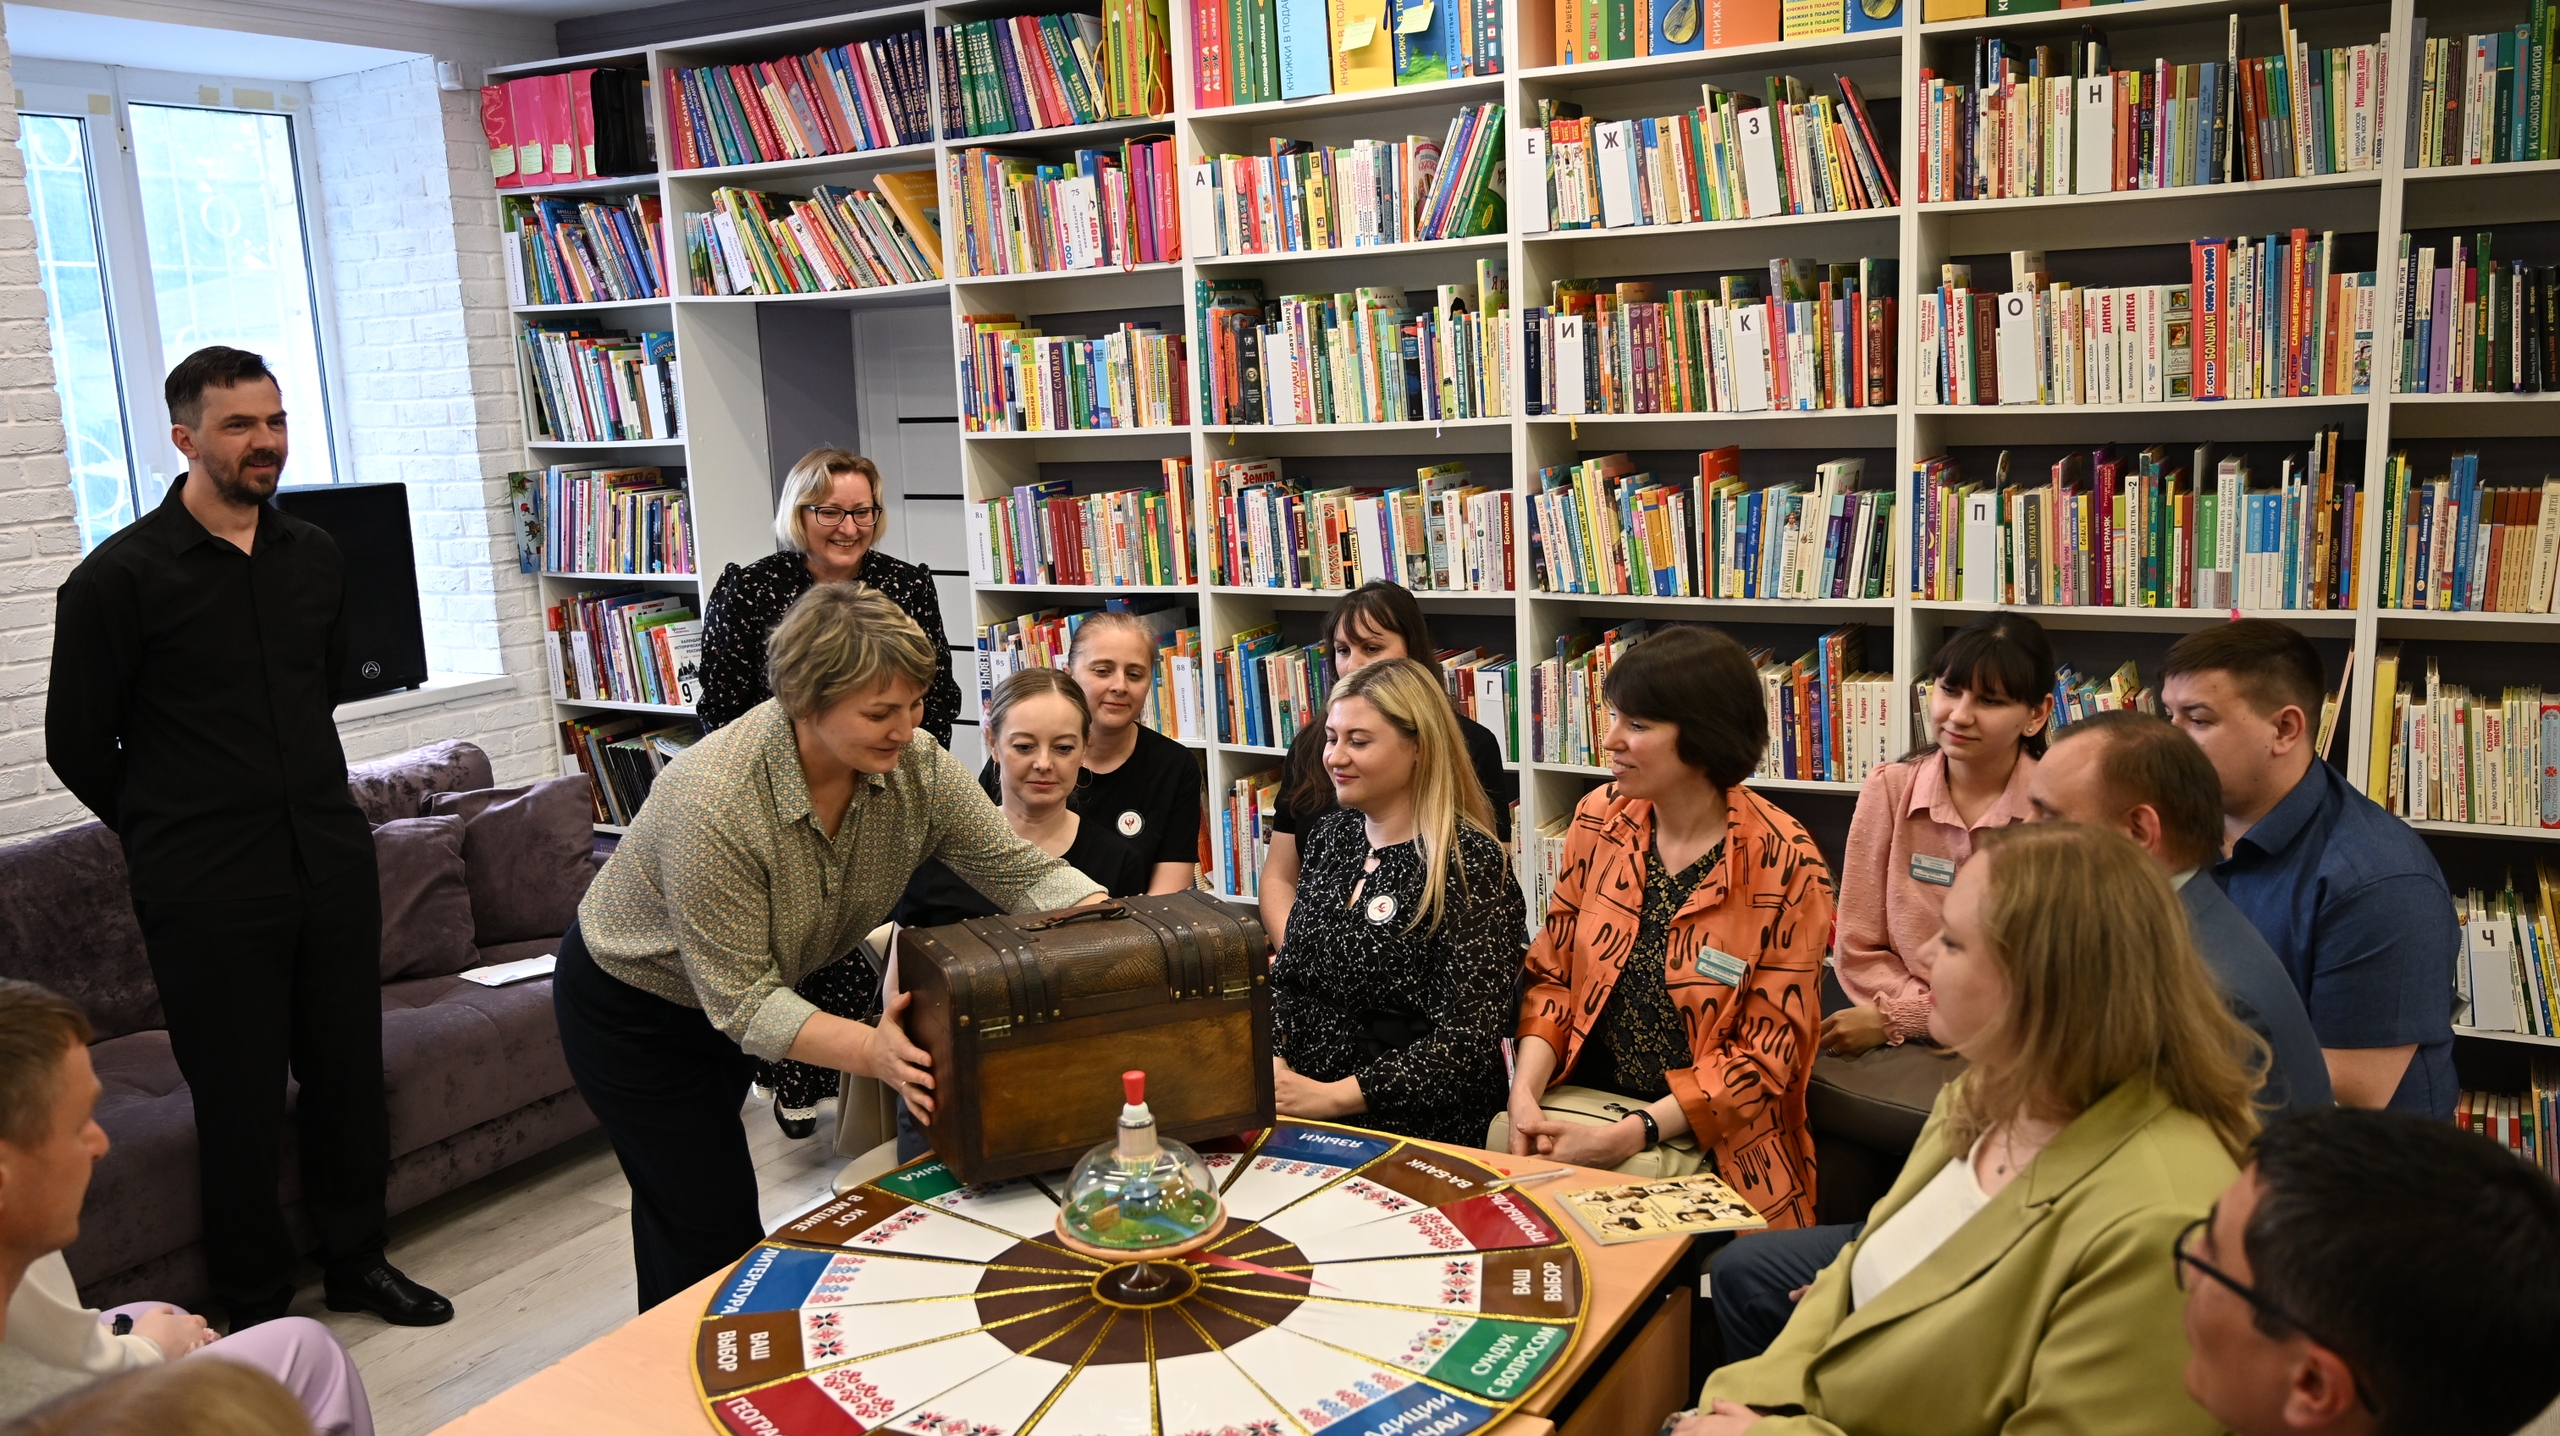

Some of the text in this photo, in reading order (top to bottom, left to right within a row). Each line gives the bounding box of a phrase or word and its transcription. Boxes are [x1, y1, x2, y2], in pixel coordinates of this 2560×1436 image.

[1813, 1, 1841, 9] ПОДАРОК
[1813, 10, 1841, 18] ПОДАРОК
[1786, 30, 1807, 38] КНИЖКИ
[1813, 26, 1841, 34] ПОДАРОК
[1813, 18, 1841, 26] ПОДАРОК
[955, 34, 967, 75] БАСНИ
[1201, 46, 1211, 92] АЗБУКА
[1212, 45, 1221, 91] АЗБУКА
[1237, 42, 1247, 95] ВОЛШЕБНЫЙ
[1259, 13, 1270, 97] ВОЛШЕБНЫЙ КАРАНДАШ
[1284, 45, 1294, 91] КНИЖКИ
[871, 72, 883, 101] МЕДВЕДЯ
[2354, 50, 2366, 108] Мишкина каша
[2090, 85, 2101, 104] Н
[2530, 45, 2542, 149] И. СОКОЛОВ-МИКИТОВ
[680, 94, 695, 163] ЛЕСНЫЕ СКАЗКИ
[1603, 131, 1619, 149] Ж
[1723, 113, 1731, 140] ЖИВОТНЫХ
[1528, 138, 1535, 154] Е
[1071, 188, 1079, 196] 75
[1196, 171, 1205, 185] А
[1088, 216, 1099, 249] СПОРТ
[1065, 246, 1074, 266] 600
[2203, 249, 2215, 282] ЗНАНИЙ
[2294, 239, 2302, 273] СОВЕТЫ
[2007, 298, 2023, 316] О
[2126, 293, 2136, 332] ДИНКА
[2204, 284, 2215, 312] КНИГА
[2397, 287, 2405, 312] СТРАЖЕ
[1740, 314, 1751, 332] К
[2102, 295, 2112, 334] ДИНКА
[2397, 314, 2403, 323] НА
[2478, 311, 2486, 335] Робин
[1562, 323, 1574, 338] И
[2203, 315, 2216, 360] БОЛЬШАЯ
[2291, 316, 2299, 346] САМЫЕ
[1312, 345, 1320, 378] БИАНКИ
[1874, 331, 1882, 365] КИПЛИНГ
[1052, 349, 1061, 389] СЛОВАРЬ
[1241, 469, 1276, 485] Земля
[975, 511, 984, 519] 81
[1929, 514, 1935, 522] 38
[1974, 504, 1985, 520] П
[1541, 522, 1549, 545] СТРАНЕ
[2028, 504, 2037, 559] ЗОЛОТАЯ РОЗА
[2458, 515, 2469, 568] ЗОЛОТОЙ КЛЮЧИК
[1351, 537, 1359, 570] БЫЛИНЫ
[2103, 516, 2112, 589] Евгений ПЕРМЯК
[2382, 509, 2392, 595] Константин УШИНСКИЙ
[1785, 549, 1795, 593] КРАПИВИН
[681, 682, 693, 703] 9
[1487, 681, 1493, 694] Г
[2486, 715, 2494, 752] Сказочные
[2482, 930, 2495, 947] Ч
[1299, 1134, 1364, 1148] ЯЗЫКИ
[1406, 1159, 1474, 1189] ВА-БАНК
[791, 1199, 850, 1232] МЕШКЕ
[833, 1208, 867, 1227] КОТ
[720, 1247, 780, 1314] ЛИТЕРАТУРА
[1513, 1269, 1531, 1295] ВАШ
[1543, 1262, 1562, 1301] ВЫБОР
[717, 1330, 737, 1372] ВЫБОР
[750, 1331, 770, 1360] ВАШ
[1471, 1333, 1519, 1376] СУНДУК
[1487, 1326, 1559, 1397] С ВОПРОСОМ
